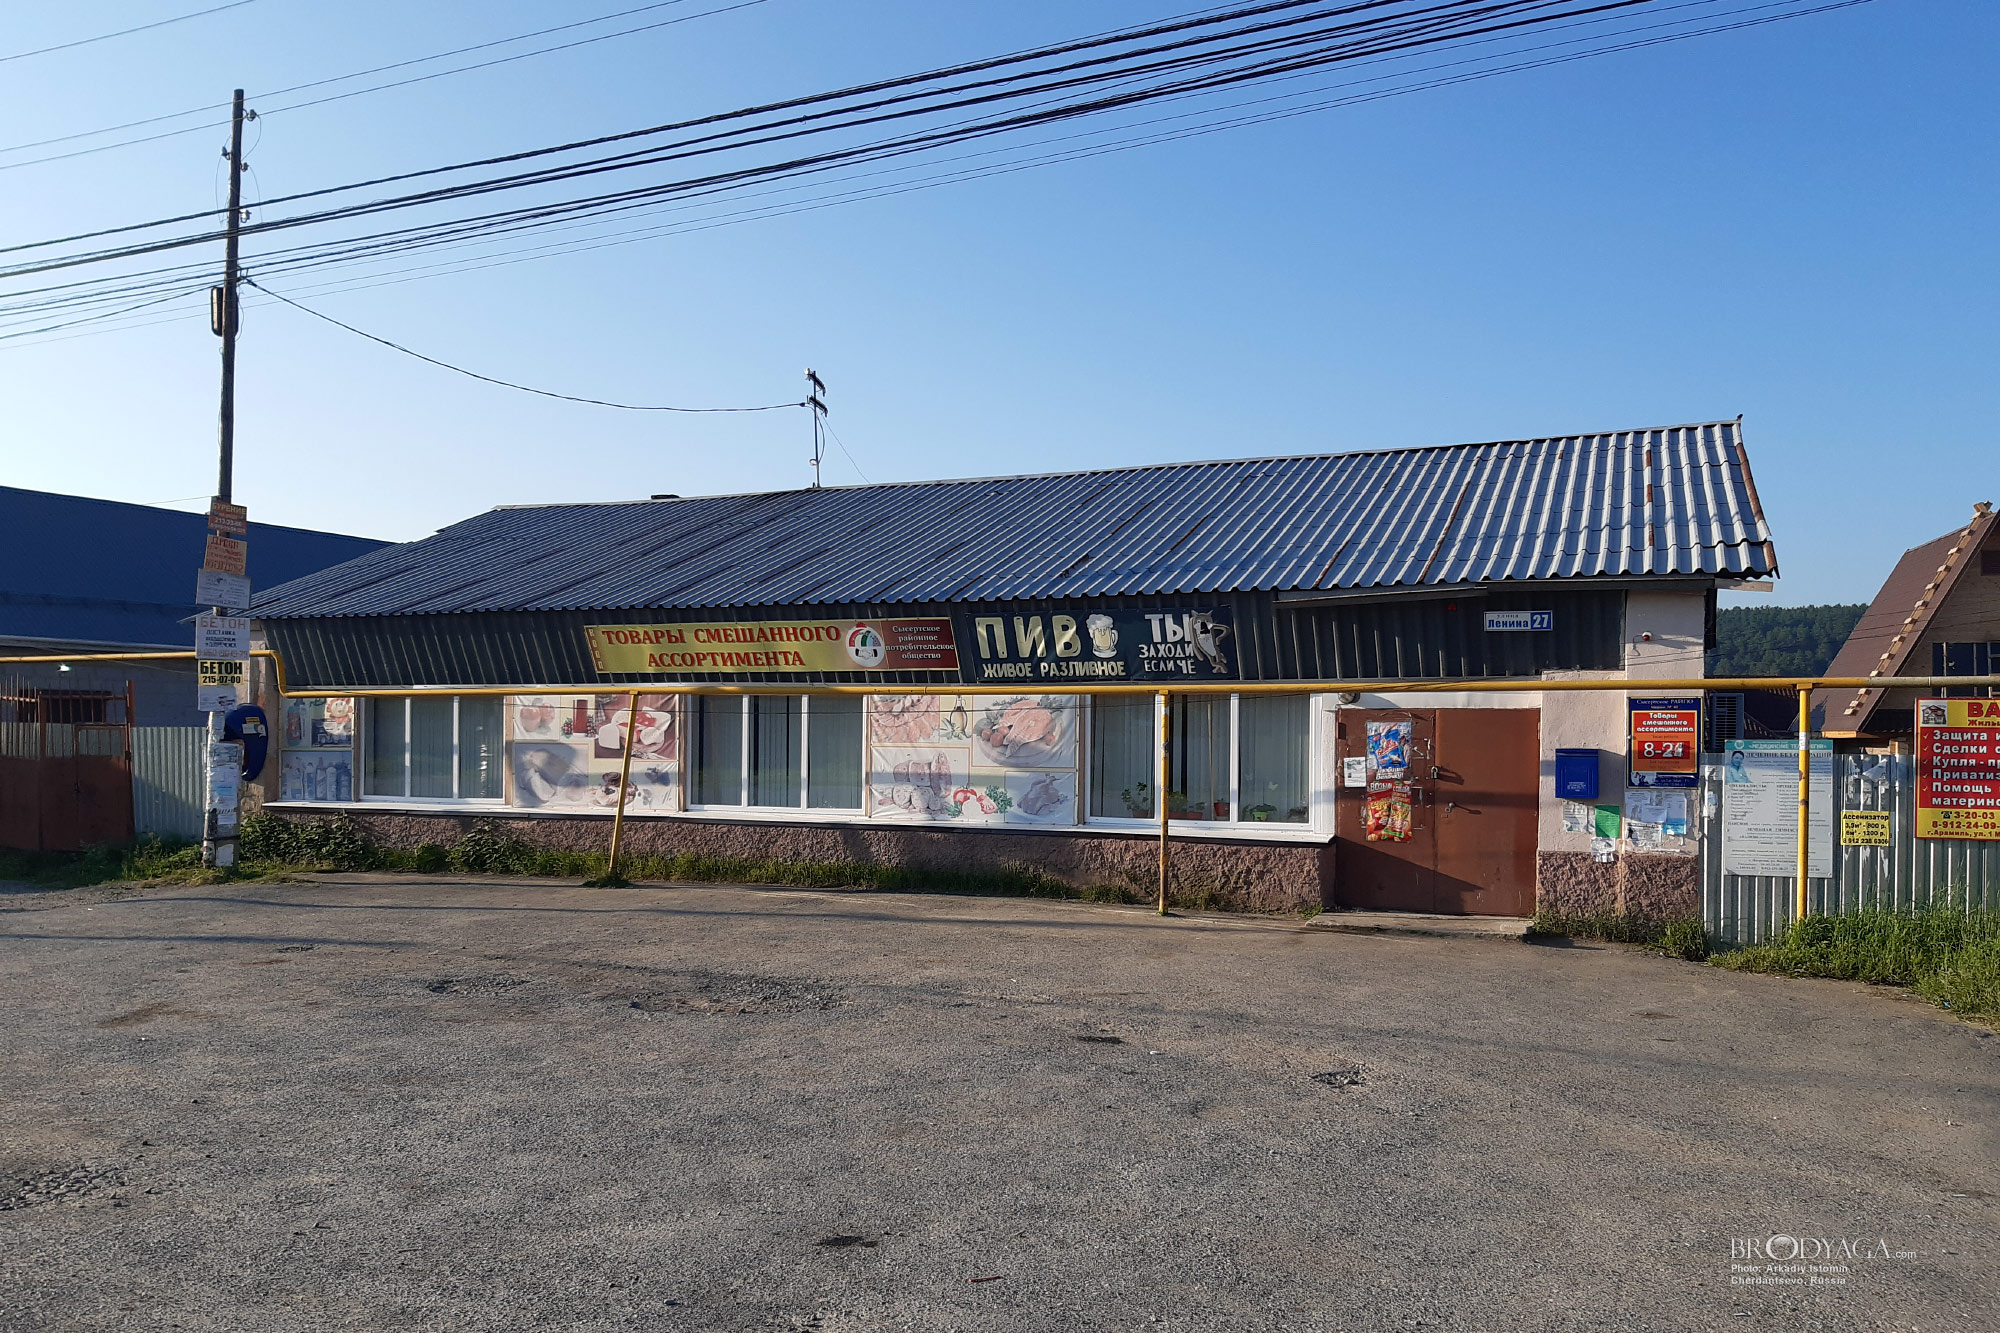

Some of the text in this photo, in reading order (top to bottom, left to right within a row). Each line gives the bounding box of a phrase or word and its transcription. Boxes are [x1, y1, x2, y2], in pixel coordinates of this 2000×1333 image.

[200, 617, 246, 629] БЕТОН
[1487, 614, 1549, 628] Ленина 27
[892, 625, 941, 633] Сысертское
[1144, 613, 1192, 643] ТЫ
[601, 625, 841, 645] ТОВАРЫ СМЕШАННОГО
[898, 634, 939, 643] районное
[885, 643, 955, 652] потребительское
[1138, 643, 1195, 658] ЗАХОДИ
[647, 650, 806, 668] АССОРТИМЕНТА
[901, 652, 941, 660] общество
[200, 661, 243, 675] БЕТОН
[982, 660, 1127, 678] ЖИВОЕ РАЗЛИВНОЕ
[1144, 658, 1197, 674] ЕСЛИ ЧЁ
[202, 675, 241, 684] 215-07-00
[1649, 712, 1677, 720] Товары
[1967, 702, 2000, 718] ВА
[1932, 729, 1988, 742] Защита
[1932, 742, 1987, 755] Сделки
[1932, 755, 1976, 769] Купля
[1932, 781, 1992, 795] Помощь
[1842, 813, 1889, 821] Ассенизатор
[1953, 811, 1995, 820] 3-20-03
[1931, 820, 2000, 830] 8-912-24-09-
[1927, 829, 1972, 837] г.Арамиль,
